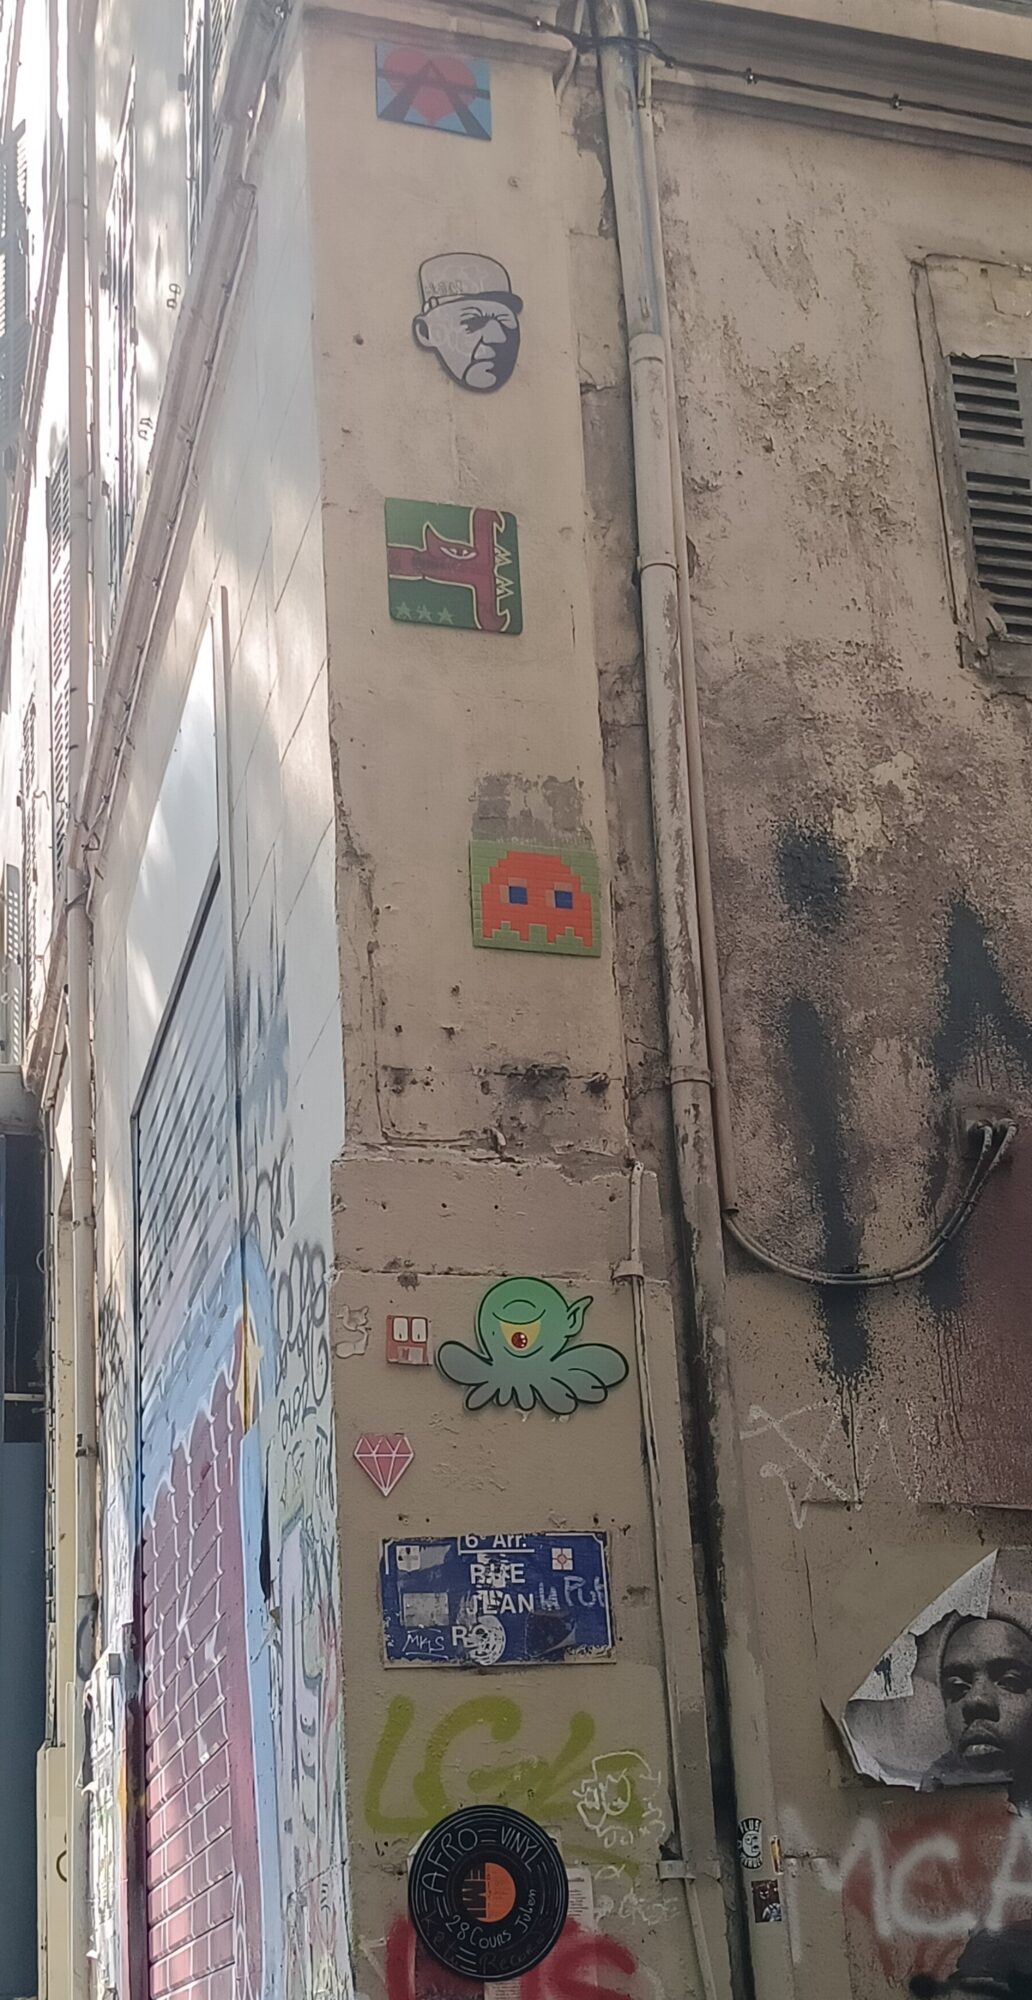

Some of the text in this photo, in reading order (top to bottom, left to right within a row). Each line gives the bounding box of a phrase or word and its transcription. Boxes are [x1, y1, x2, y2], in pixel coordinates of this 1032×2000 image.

[421, 1825, 542, 1894] AFRO VINYL
[444, 1914, 471, 1942] 28
